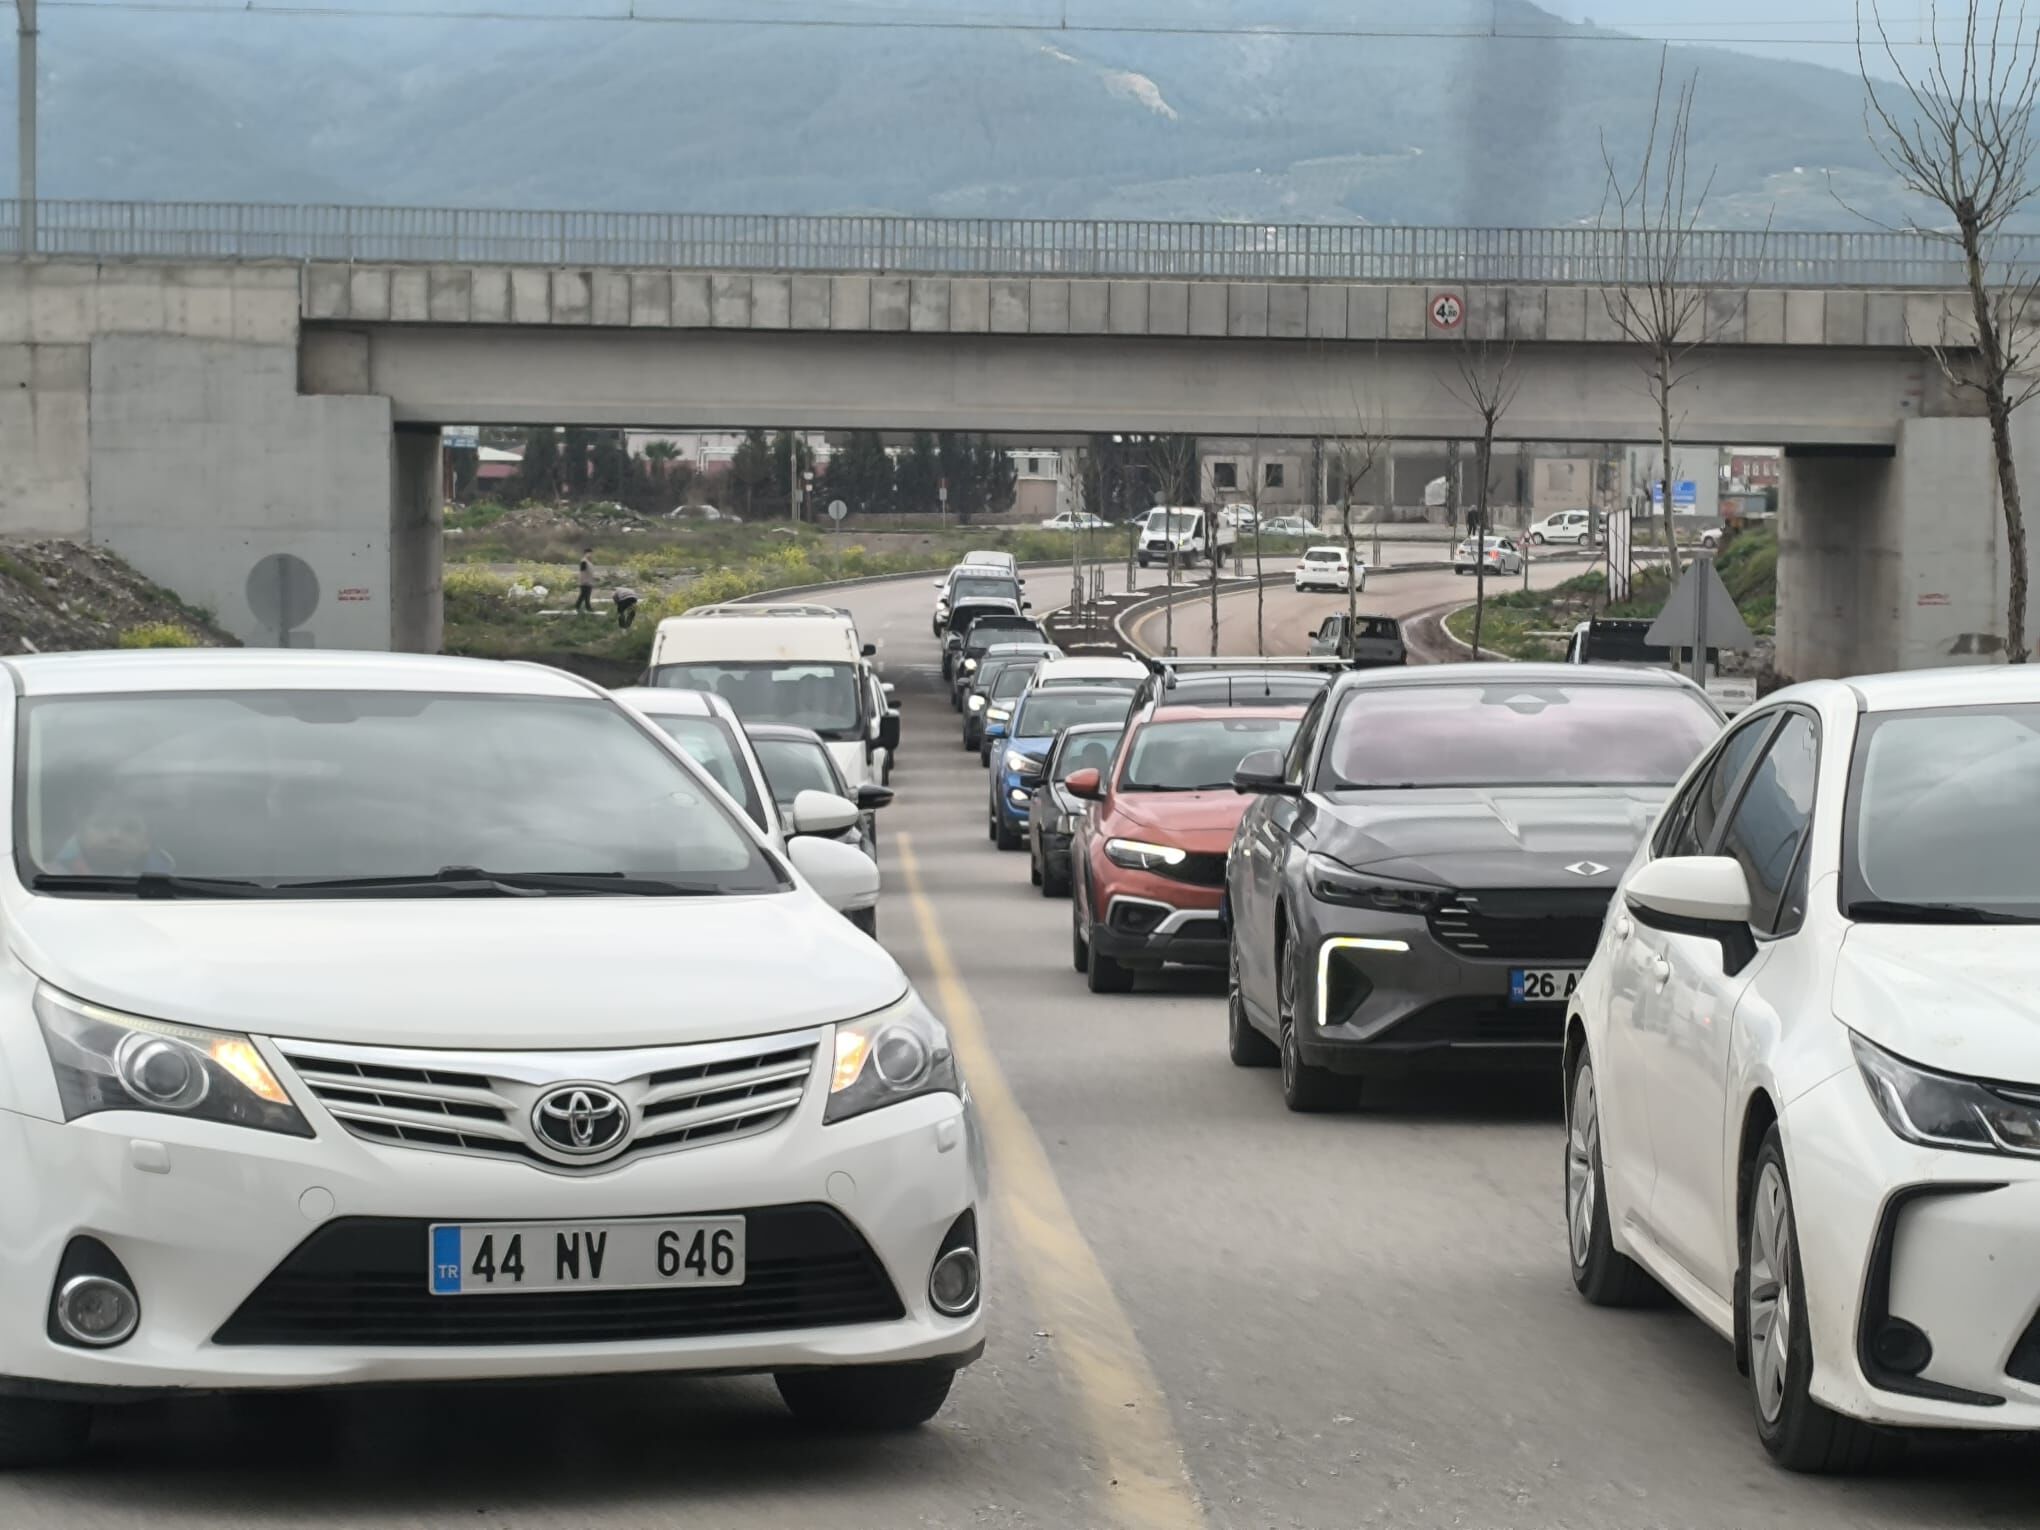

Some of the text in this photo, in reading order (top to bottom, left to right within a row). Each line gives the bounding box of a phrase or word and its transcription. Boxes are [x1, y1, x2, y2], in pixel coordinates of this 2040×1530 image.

[1525, 972, 1555, 998] 26
[1563, 972, 1584, 998] A
[438, 1229, 734, 1283] TR 44 NV 646
